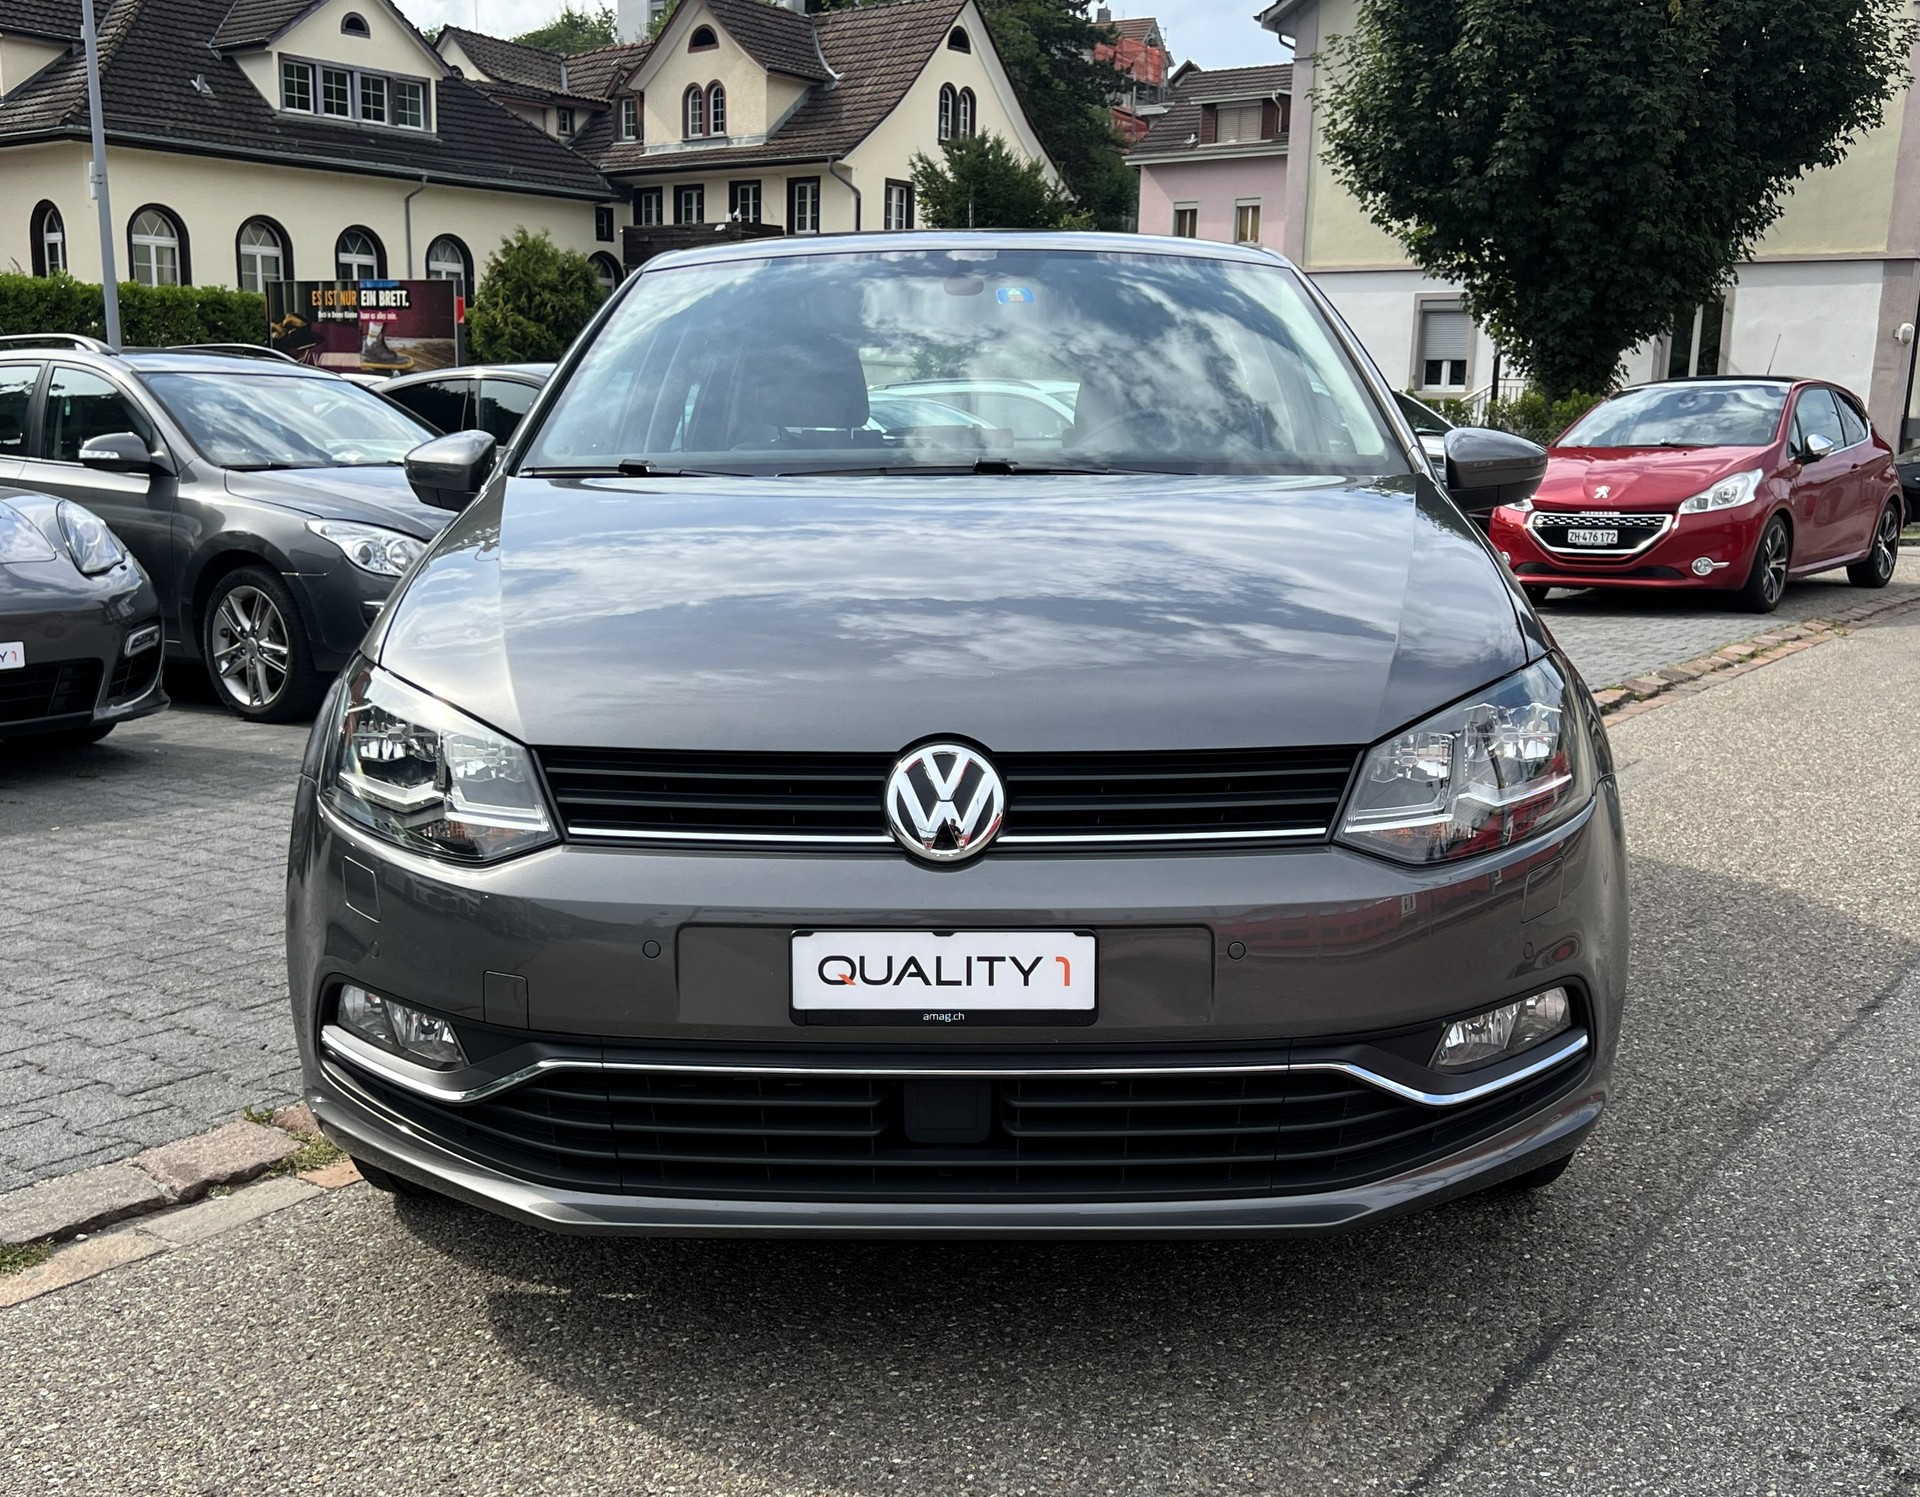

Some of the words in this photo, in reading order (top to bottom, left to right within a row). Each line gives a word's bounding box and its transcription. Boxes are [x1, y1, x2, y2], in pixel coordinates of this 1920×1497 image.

[312, 290, 322, 306] ES
[325, 290, 337, 306] IST
[340, 290, 357, 306] NUR
[361, 290, 376, 307] EIN
[379, 290, 409, 307] BRETT.
[818, 955, 1044, 986] QUALITY
[1056, 956, 1071, 987] 1
[923, 1011, 965, 1023] amag.ch
